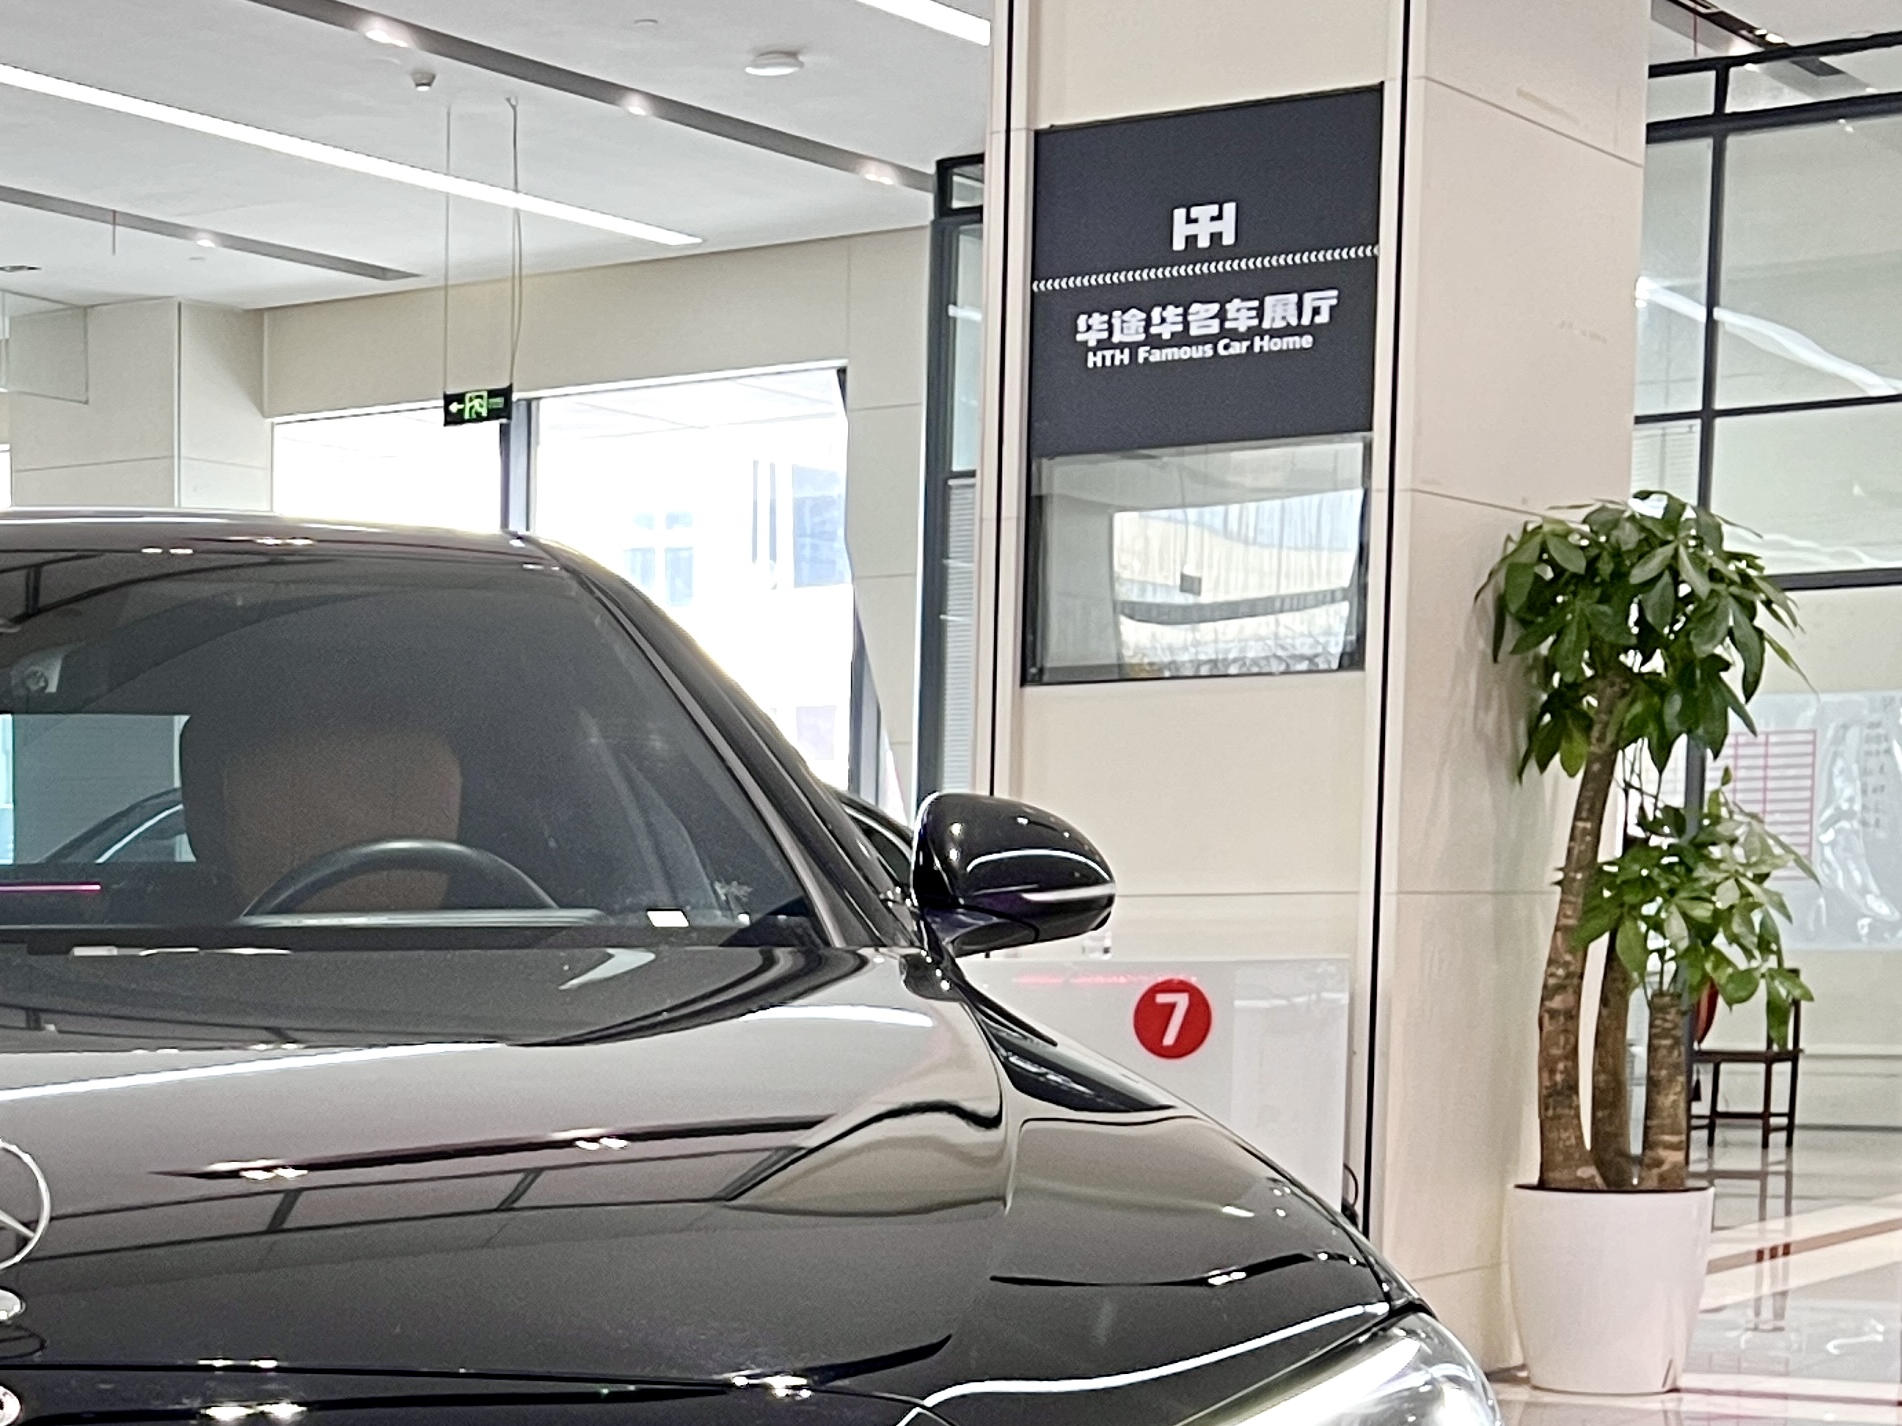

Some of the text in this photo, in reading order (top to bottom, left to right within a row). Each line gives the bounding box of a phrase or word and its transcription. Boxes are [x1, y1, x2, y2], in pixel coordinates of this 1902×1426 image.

[1075, 289, 1339, 347] 华途华名车展厅
[1087, 334, 1314, 368] HTH Famous Car Home
[1155, 992, 1190, 1046] 7
